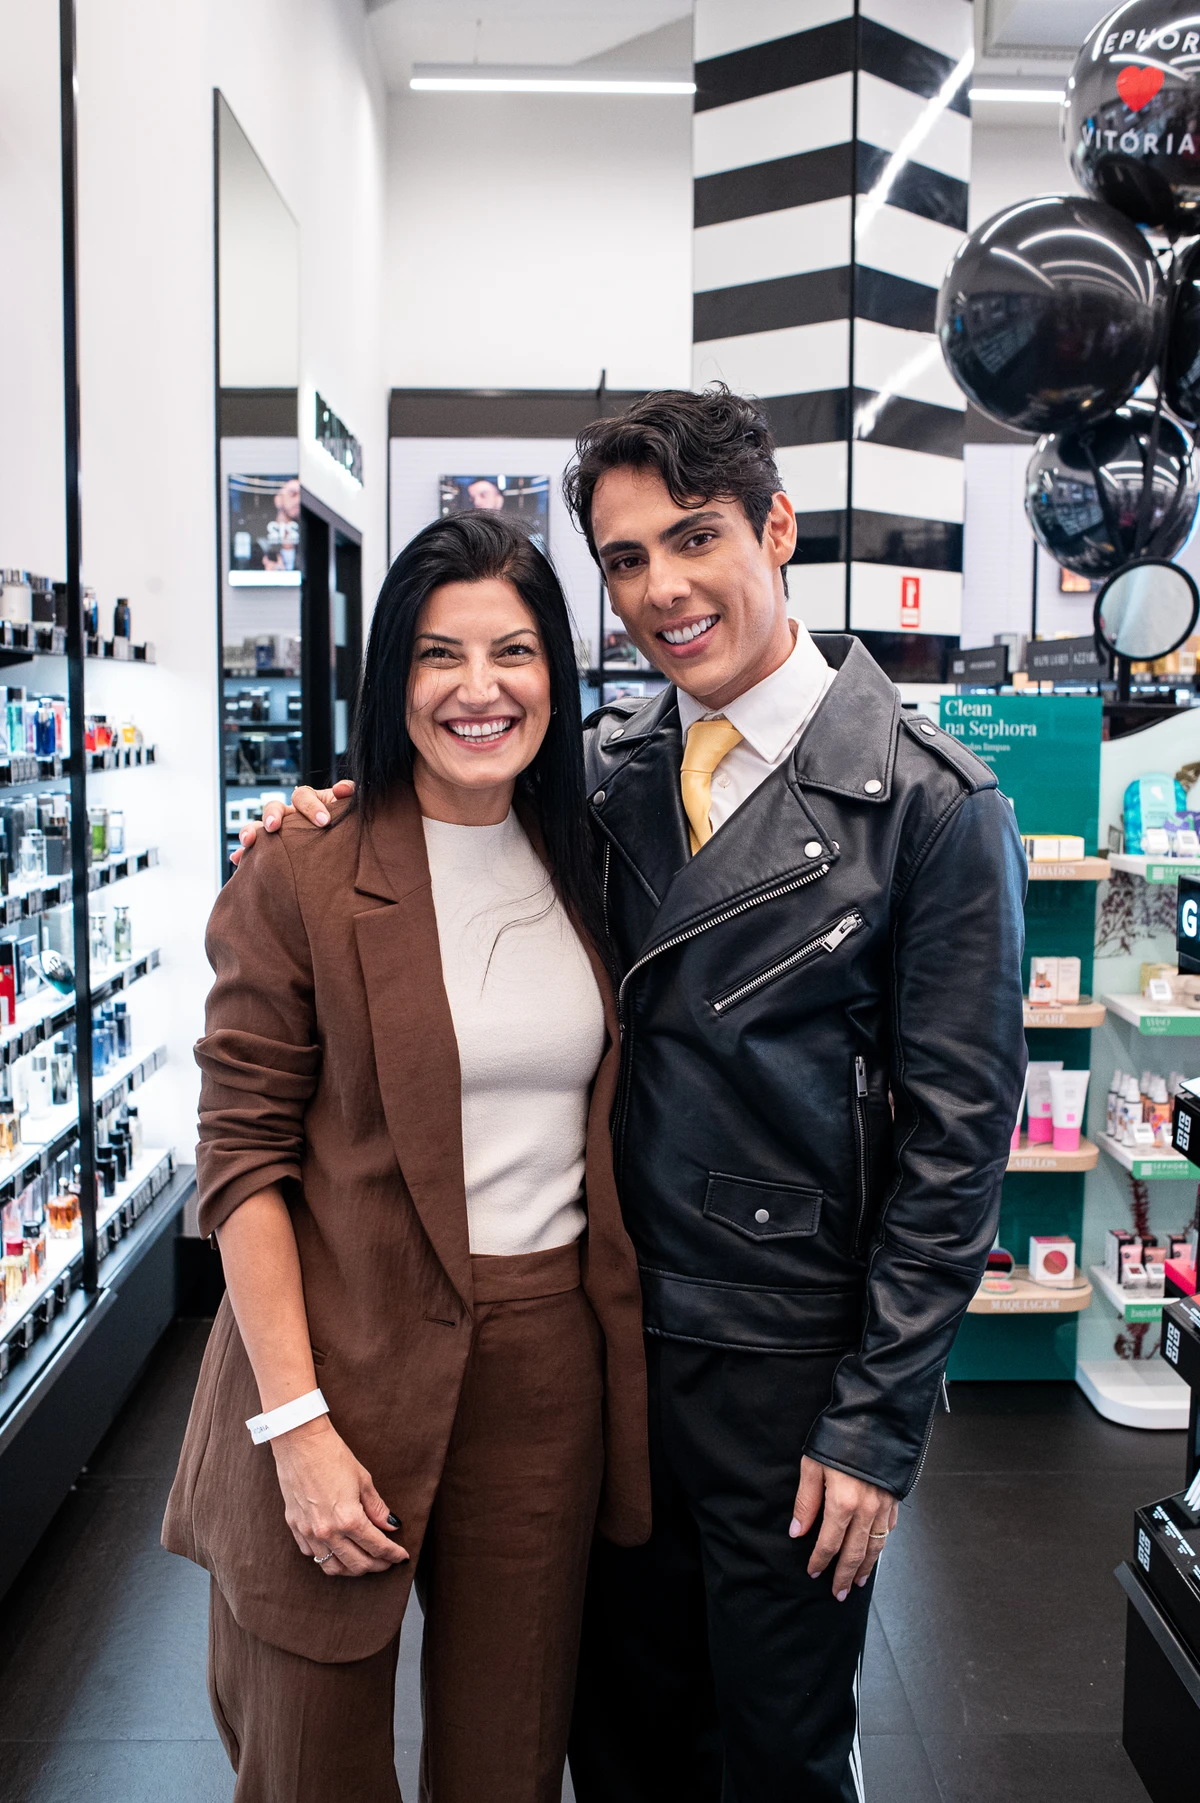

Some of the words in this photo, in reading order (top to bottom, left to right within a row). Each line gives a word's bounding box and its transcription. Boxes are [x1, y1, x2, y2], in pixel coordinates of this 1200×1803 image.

[1102, 27, 1200, 54] EPHOR
[1082, 126, 1195, 155] VITÓRIA
[945, 699, 992, 717] Clean
[945, 722, 965, 735] na
[969, 719, 1037, 739] Sephora
[1012, 1157, 1057, 1168] ABELOS
[991, 1299, 1061, 1312] MAQUIAGEM
